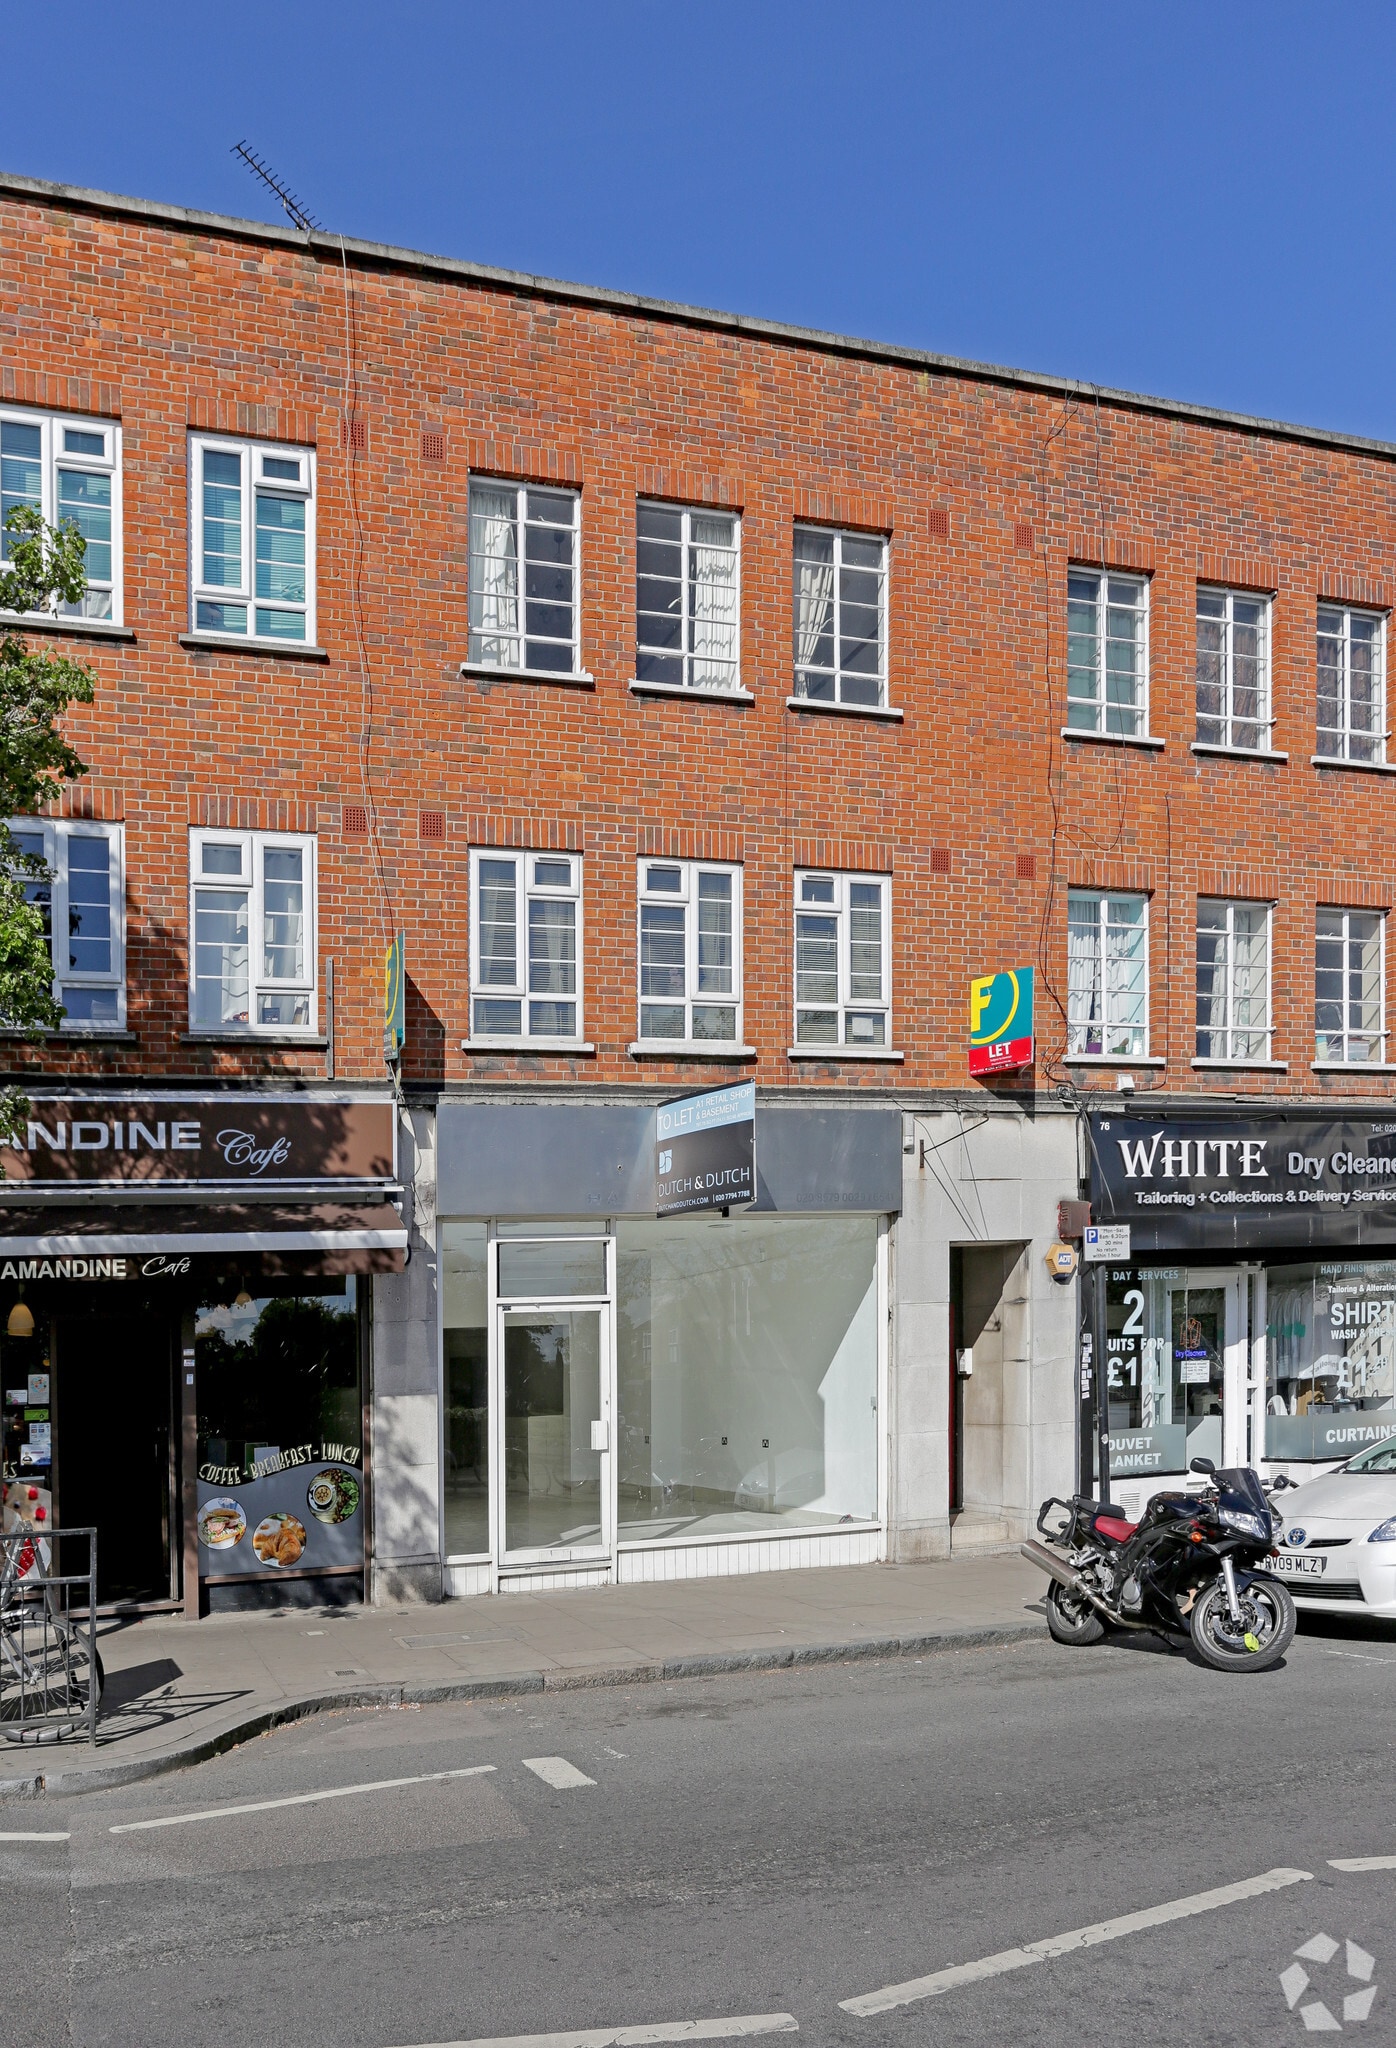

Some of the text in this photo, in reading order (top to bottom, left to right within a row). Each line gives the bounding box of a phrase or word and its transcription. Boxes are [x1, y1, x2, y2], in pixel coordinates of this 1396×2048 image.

[989, 1042, 1011, 1058] LET
[705, 1093, 729, 1106] RETAIL
[730, 1087, 752, 1100] SHOP
[658, 1113, 671, 1131] TO
[674, 1107, 694, 1127] LET
[695, 1112, 700, 1120] &
[701, 1102, 739, 1119] BASEMENT
[1100, 1122, 1110, 1131] 76
[1371, 1124, 1383, 1132] Tel:
[216, 1129, 292, 1175] Café
[1117, 1131, 1269, 1178] WHITE
[1288, 1152, 1325, 1179] Dry
[658, 1166, 750, 1197] DUTCH & DUTCH
[1135, 1191, 1195, 1206] Tailoring
[1209, 1190, 1284, 1204] Collections
[1285, 1190, 1297, 1202] &
[1298, 1189, 1351, 1204] Delivery
[1088, 1230, 1096, 1242] P
[1058, 1255, 1071, 1263] ADT
[0, 1255, 191, 1280] AMANDINE Café
[1113, 1270, 1132, 1281] DAY
[1137, 1269, 1179, 1281] SERVICES
[1320, 1264, 1342, 1274] HAND
[1344, 1263, 1368, 1273] FINISH
[1328, 1283, 1396, 1294] Tailoring & Alteratio
[1121, 1289, 1145, 1335] 2
[1331, 1328, 1358, 1340] WASH
[1360, 1328, 1366, 1338] &
[1108, 1337, 1165, 1351] UITS FOR
[1175, 1350, 1184, 1359] Dry
[1107, 1356, 1157, 1387] £12
[198, 1463, 241, 1485] COFFEE
[250, 1443, 312, 1479] BREAKFAST
[321, 1442, 360, 1465] LUNCH
[1109, 1453, 1161, 1467] ANKET
[1265, 1556, 1317, 1572] RV09 MLZ
